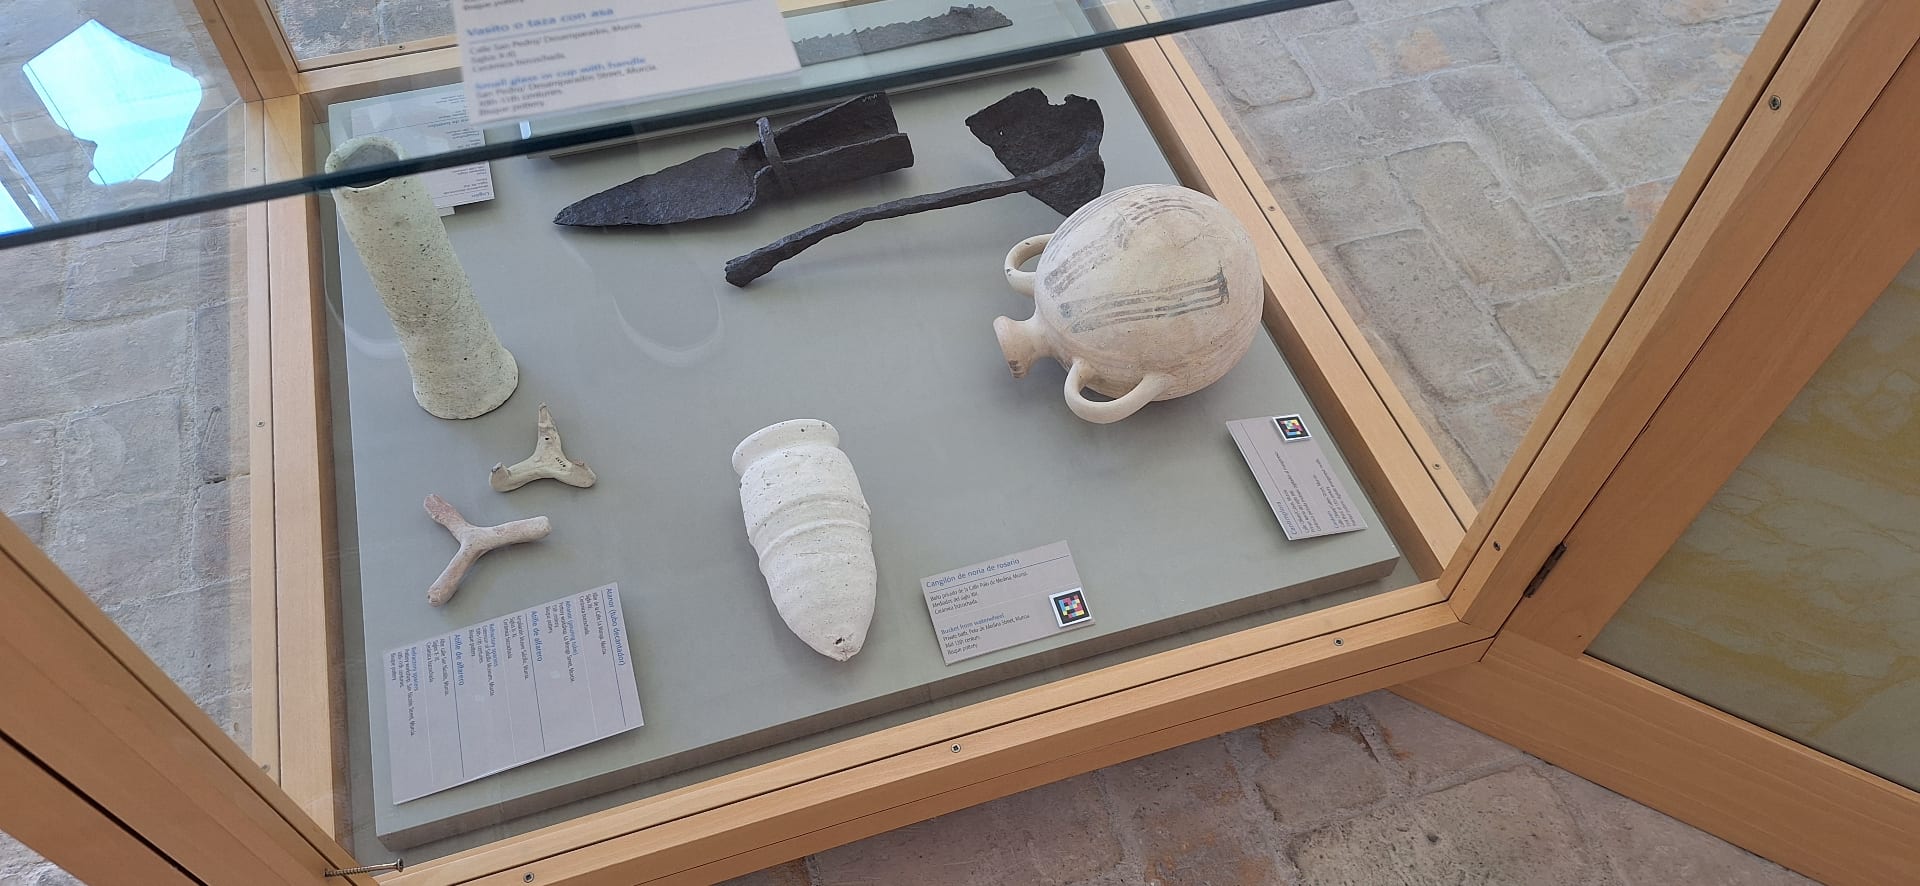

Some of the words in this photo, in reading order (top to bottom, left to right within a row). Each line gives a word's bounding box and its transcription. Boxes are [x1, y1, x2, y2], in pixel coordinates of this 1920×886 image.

[466, 22, 509, 37] Vasito
[513, 20, 524, 30] o
[526, 15, 557, 28] taza
[560, 11, 586, 23] con
[590, 7, 614, 18] asa
[475, 78, 508, 91] Small
[555, 67, 577, 78] cup
[580, 62, 605, 74] with
[607, 55, 647, 70] handle
[1274, 501, 1299, 535] Cantimplora
[925, 574, 956, 589] Cangilón
[956, 571, 966, 580] de
[966, 567, 985, 578] noria
[985, 564, 995, 573] de
[995, 558, 1020, 570] rosario
[604, 586, 615, 609] Atanor
[608, 608, 619, 627] (tubo
[940, 624, 959, 635] Bucket
[958, 620, 973, 630] from
[532, 626, 540, 636] de
[454, 650, 463, 660] de
[533, 636, 544, 662] alfarero
[611, 626, 626, 666] decantador)
[456, 660, 466, 686] alfarero
